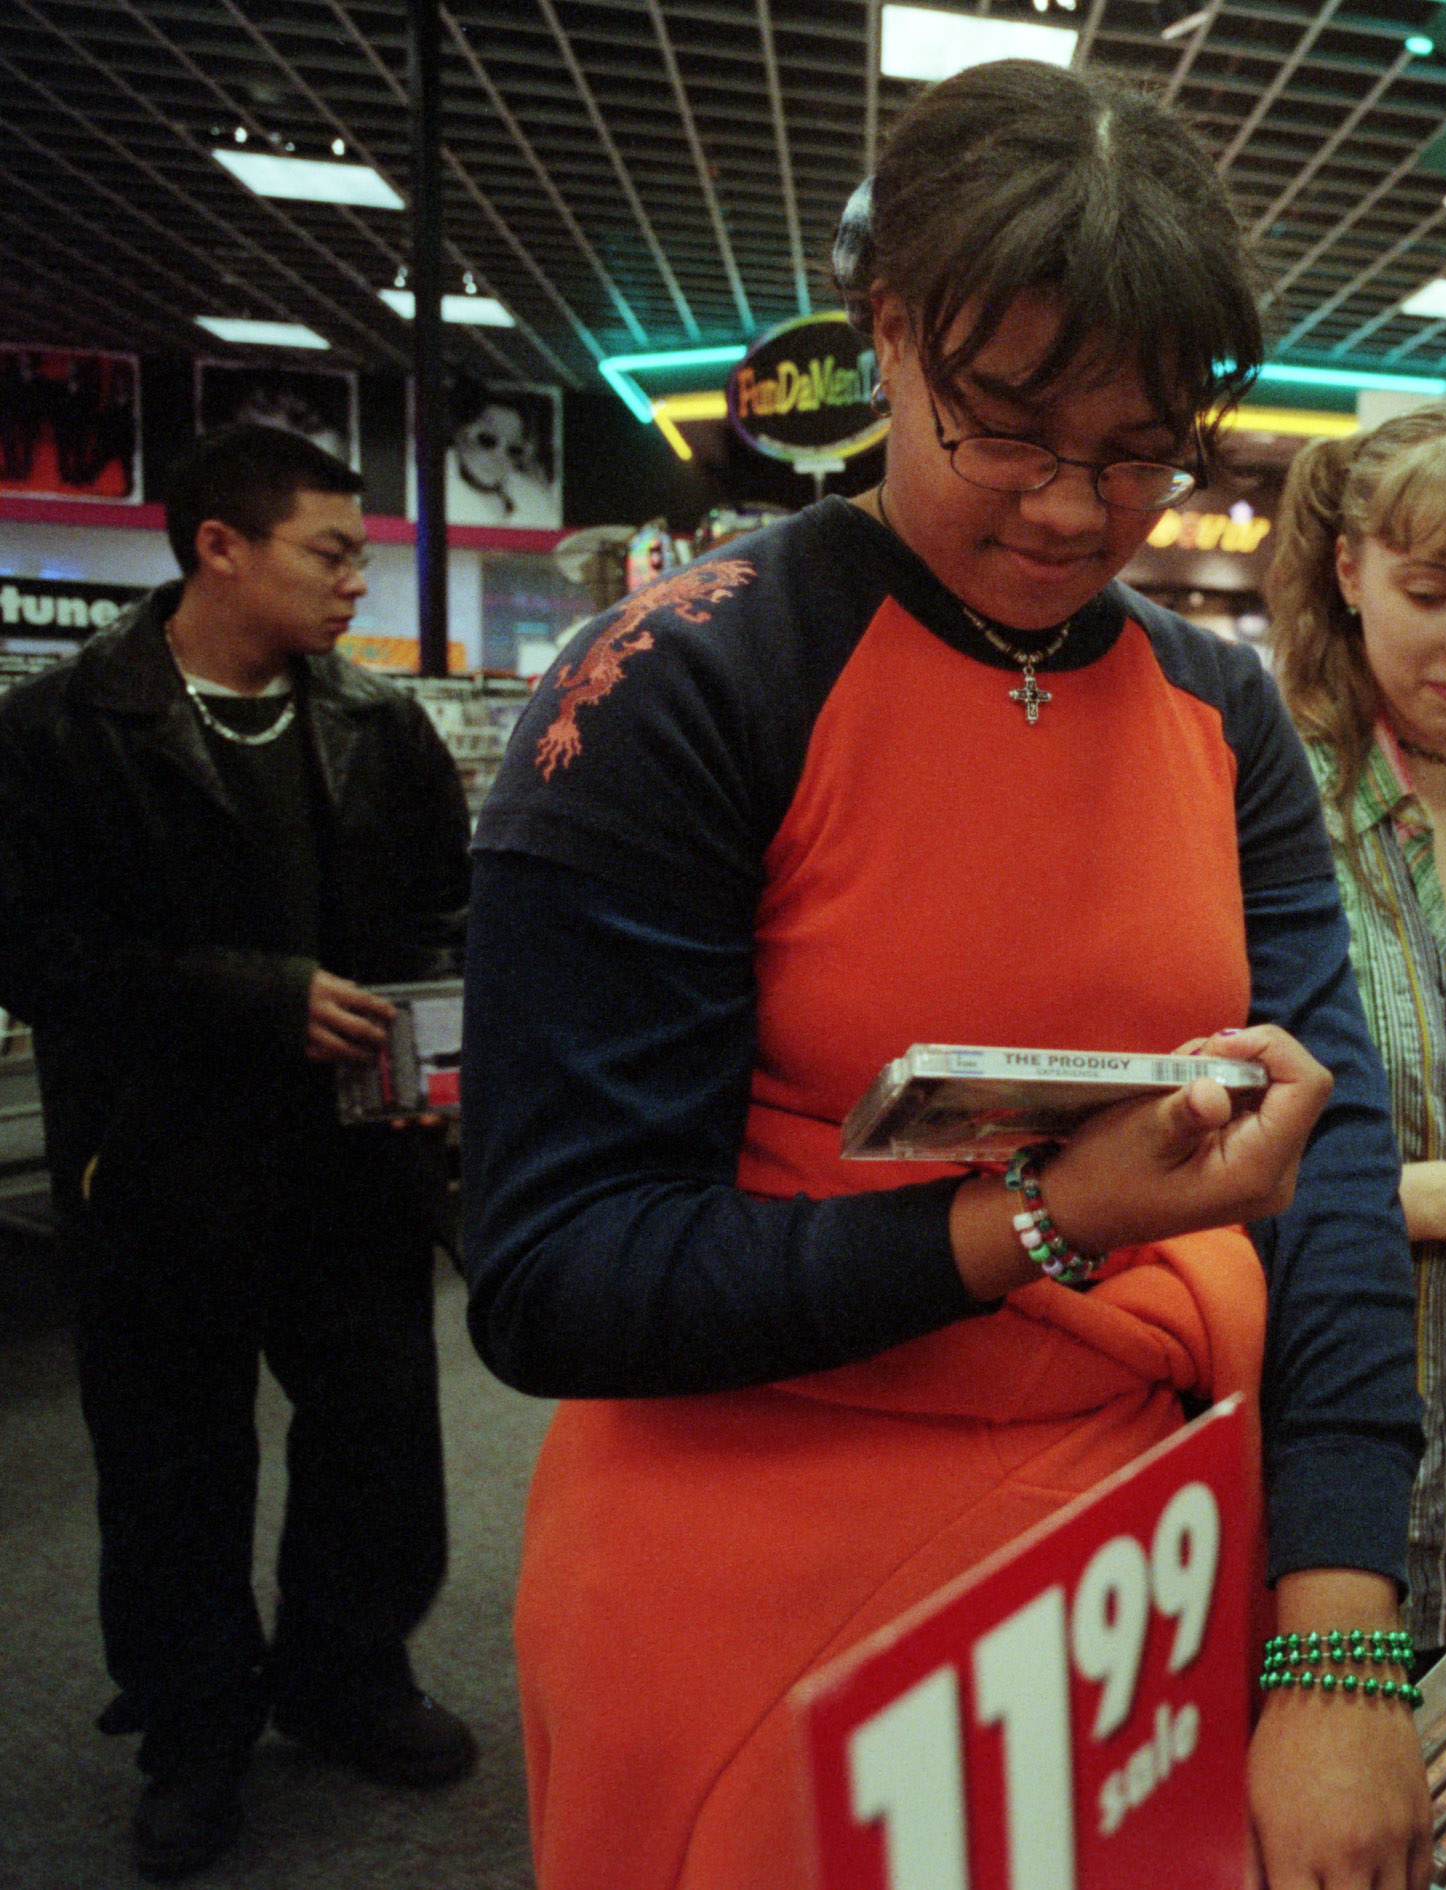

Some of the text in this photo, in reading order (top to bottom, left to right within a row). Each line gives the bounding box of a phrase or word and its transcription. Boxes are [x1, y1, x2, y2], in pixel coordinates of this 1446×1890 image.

[0, 585, 132, 628] tune
[1003, 1052, 1131, 1070] THE PRODIGY
[1100, 1702, 1199, 1835] sale
